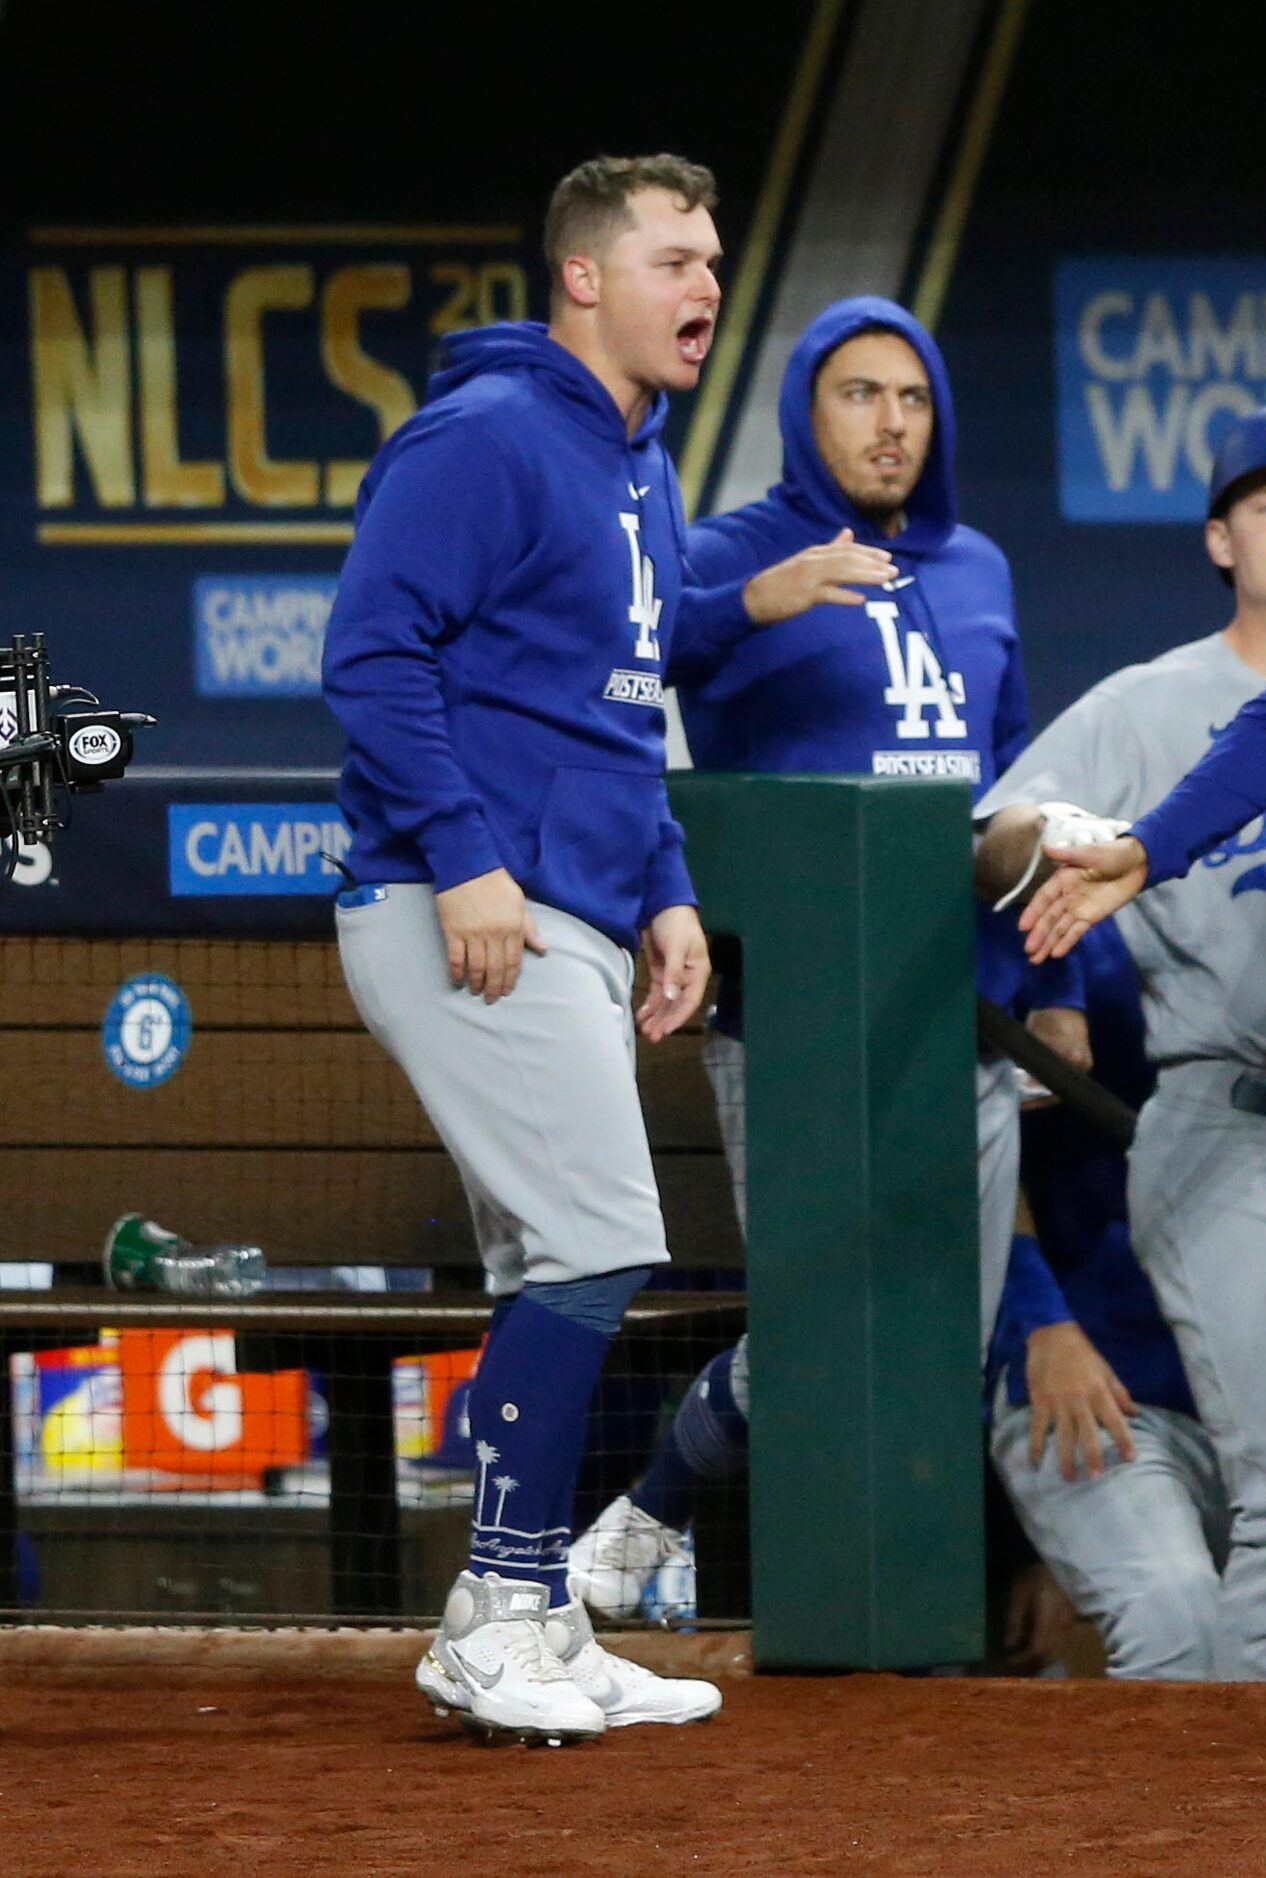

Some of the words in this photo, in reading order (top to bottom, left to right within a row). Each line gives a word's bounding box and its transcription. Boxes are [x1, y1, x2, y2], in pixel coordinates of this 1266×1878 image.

[29, 265, 413, 508] NLCS
[864, 600, 968, 739] LA
[82, 734, 108, 749] FOX
[158, 1335, 244, 1451] G
